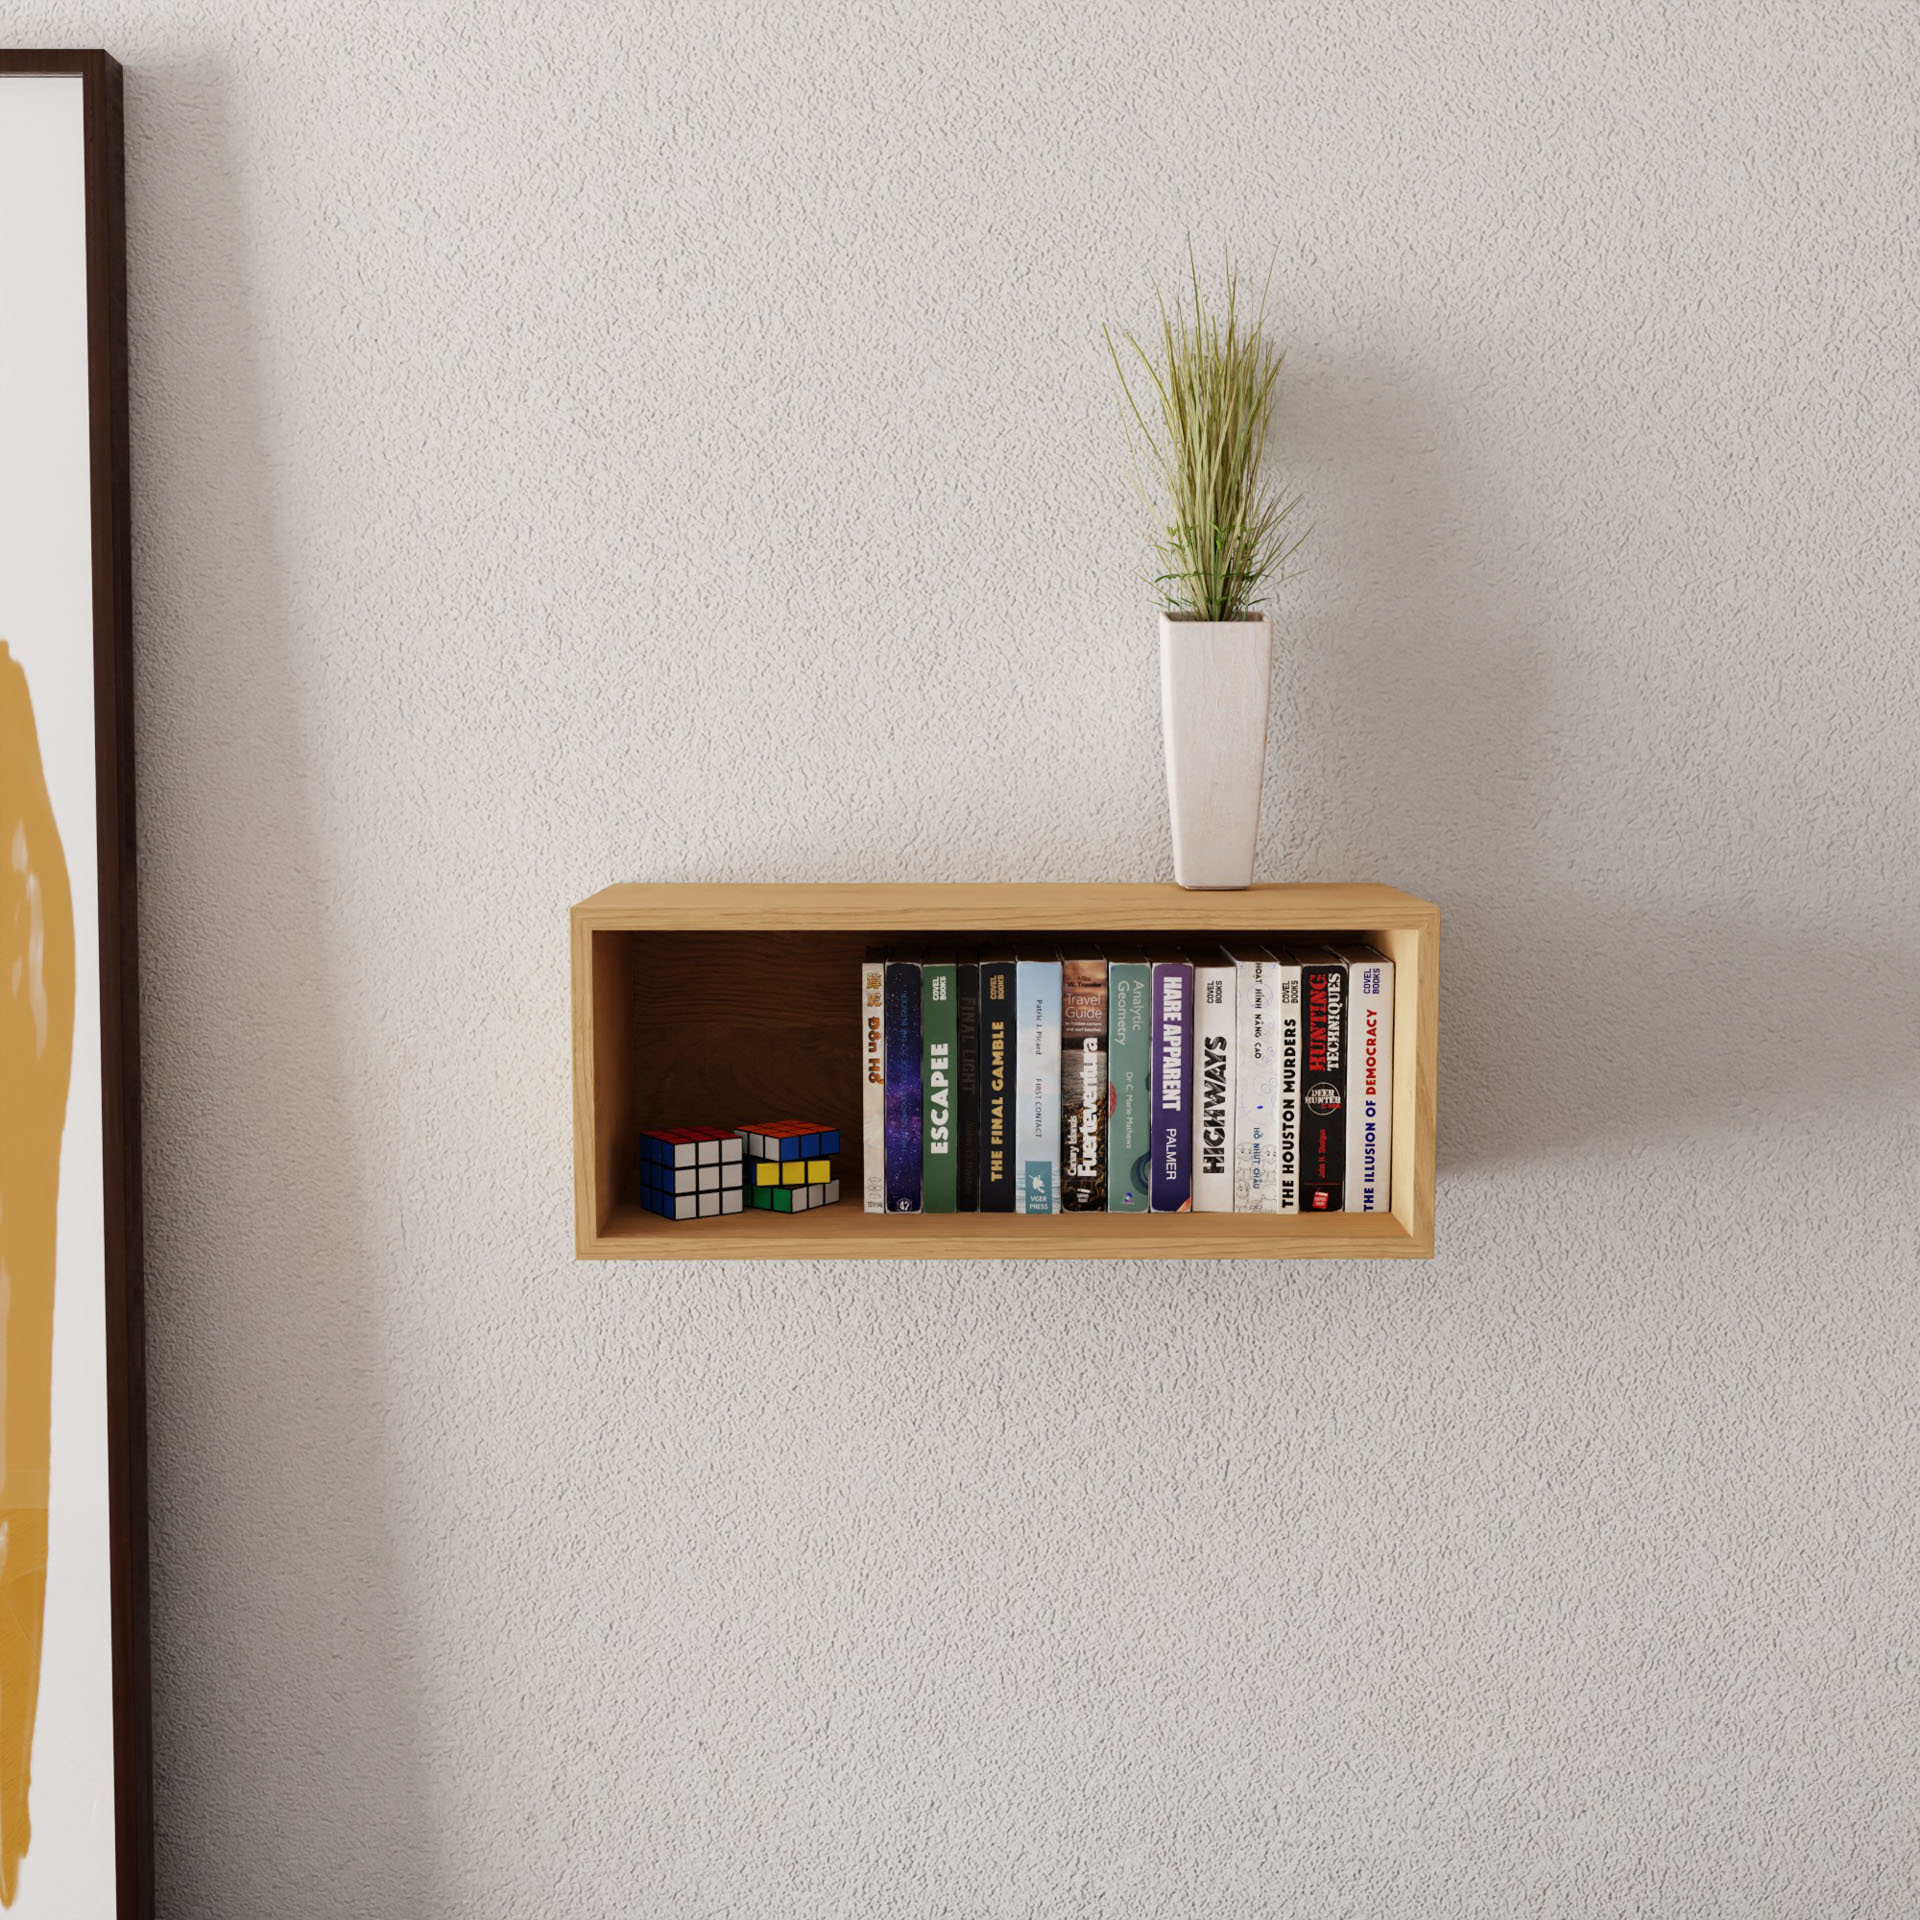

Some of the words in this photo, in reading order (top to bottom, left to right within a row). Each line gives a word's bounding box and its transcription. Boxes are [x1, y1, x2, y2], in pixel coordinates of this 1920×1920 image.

[1065, 993, 1102, 1006] Travel
[1163, 976, 1182, 1021] HARE
[1206, 980, 1214, 1004] COVEL
[1215, 980, 1223, 1004] BOOKS
[1282, 981, 1290, 1004] COVEL
[1291, 980, 1299, 1004] BOOKS
[1363, 968, 1371, 994] COVEL
[1372, 968, 1380, 994] BOOKS
[961, 997, 977, 1043] FINAL
[1065, 1006, 1102, 1019] Guide
[1114, 980, 1130, 1046] Geometry
[1129, 980, 1145, 1032] Analytic
[1254, 1014, 1264, 1038] NÂNG
[1309, 974, 1327, 1072] HUNTING
[1326, 973, 1343, 1072] TECHNIQUES
[991, 1021, 1005, 1092] GAMBLE
[1035, 1031, 1043, 1055] Picard
[1254, 1042, 1262, 1059] CAO
[1283, 1019, 1297, 1093] MURDERS
[1366, 1009, 1377, 1095] DEMOCRACY
[962, 1049, 977, 1095] LIGHT
[1162, 1023, 1182, 1112] APPARENT
[930, 1043, 949, 1154] ESCAPEE
[990, 1097, 1004, 1145] FINAL
[1077, 1037, 1098, 1177] Fuerteventura
[1202, 1036, 1227, 1174] HIGHWAYS
[1305, 1096, 1341, 1104] HUNTER
[1365, 1100, 1376, 1118] OF
[1166, 1128, 1177, 1180] PALMER
[1282, 1099, 1295, 1174] HOUSTON
[1364, 1123, 1376, 1182] ILLUSION
[990, 1151, 1004, 1183] THE
[1281, 1180, 1294, 1208] THE
[1363, 1187, 1375, 1212] THE
